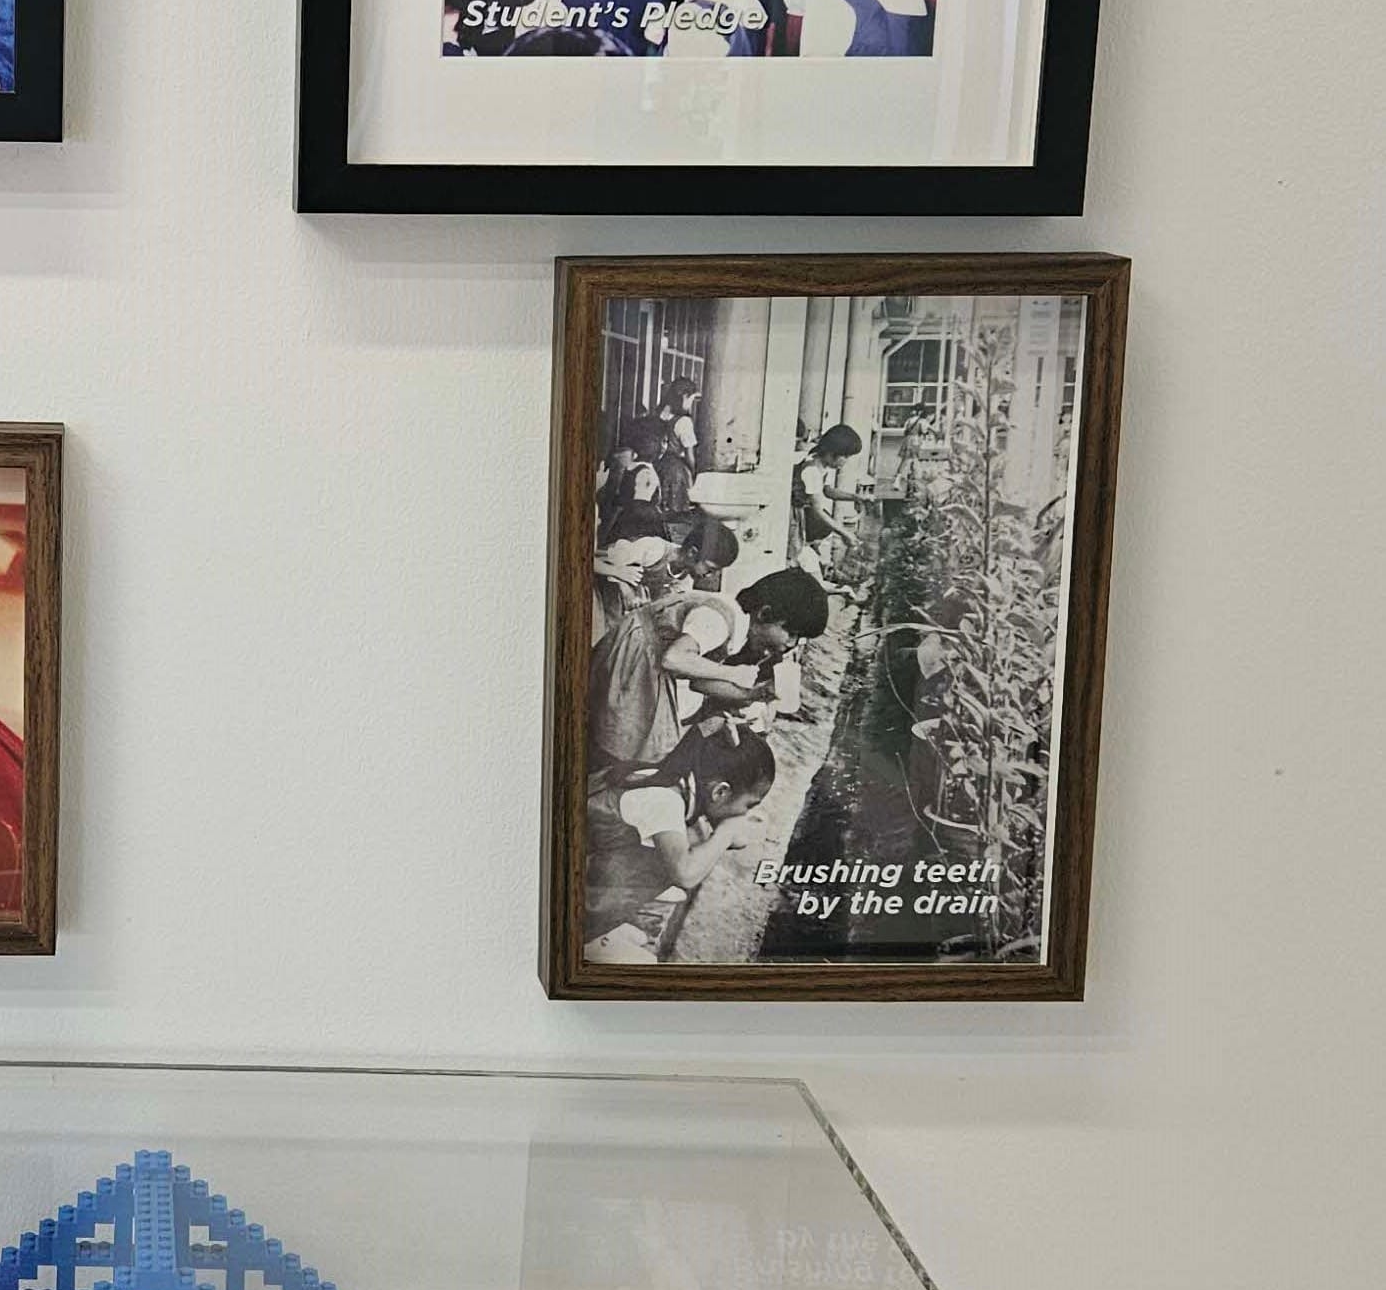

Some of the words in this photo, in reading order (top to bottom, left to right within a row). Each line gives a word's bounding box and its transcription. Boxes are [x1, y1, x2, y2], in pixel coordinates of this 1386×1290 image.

[640, 1, 766, 35] Pledge
[755, 859, 903, 888] Brushing
[913, 858, 1001, 884] teeth
[797, 890, 840, 920] by
[850, 890, 903, 915] the
[914, 890, 1000, 915] drain
